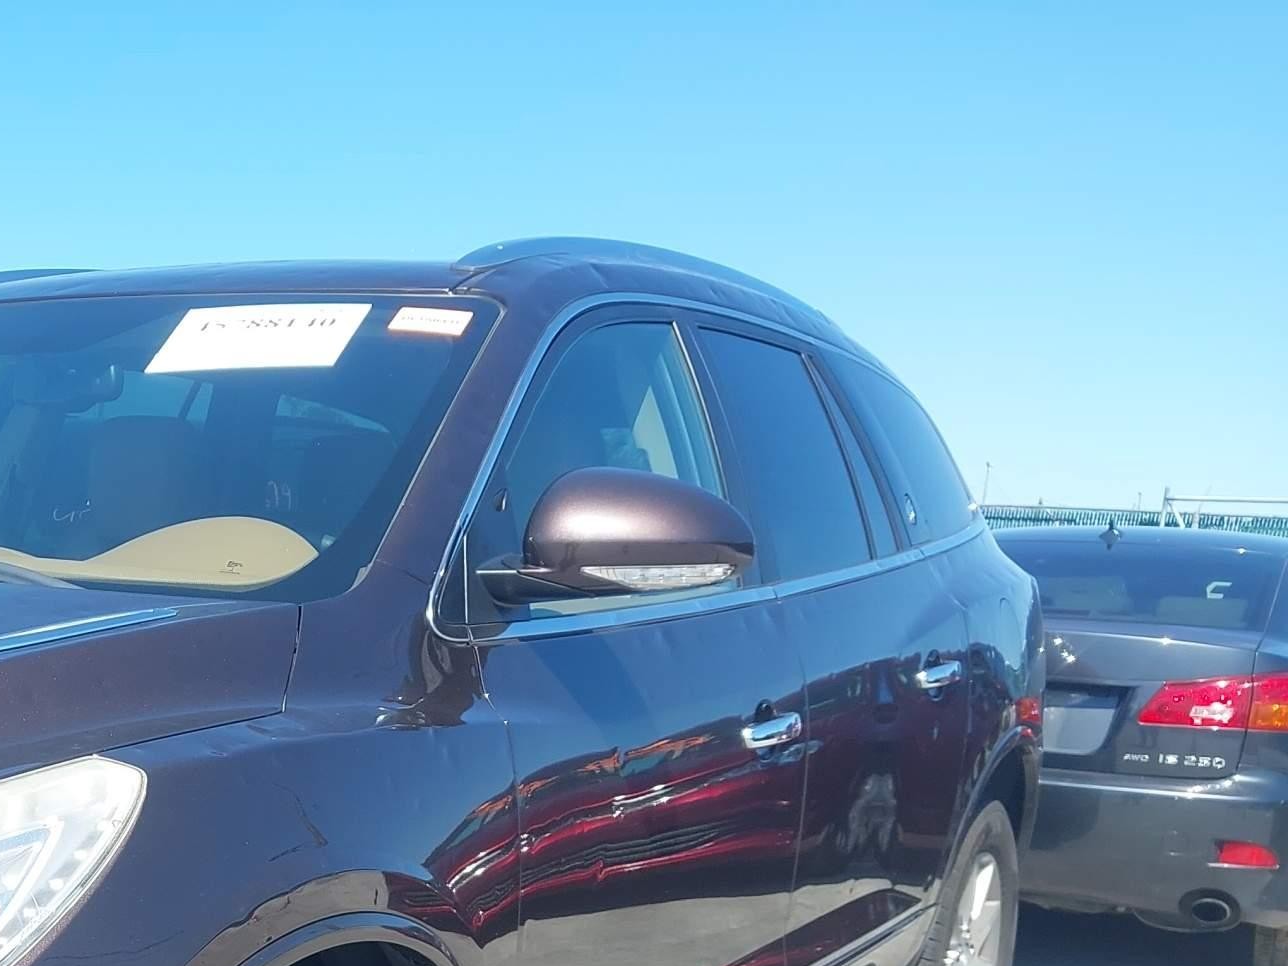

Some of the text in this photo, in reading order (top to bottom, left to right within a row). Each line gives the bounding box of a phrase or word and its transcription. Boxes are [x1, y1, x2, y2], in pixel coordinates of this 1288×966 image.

[1123, 753, 1226, 769] AWD IS 250
